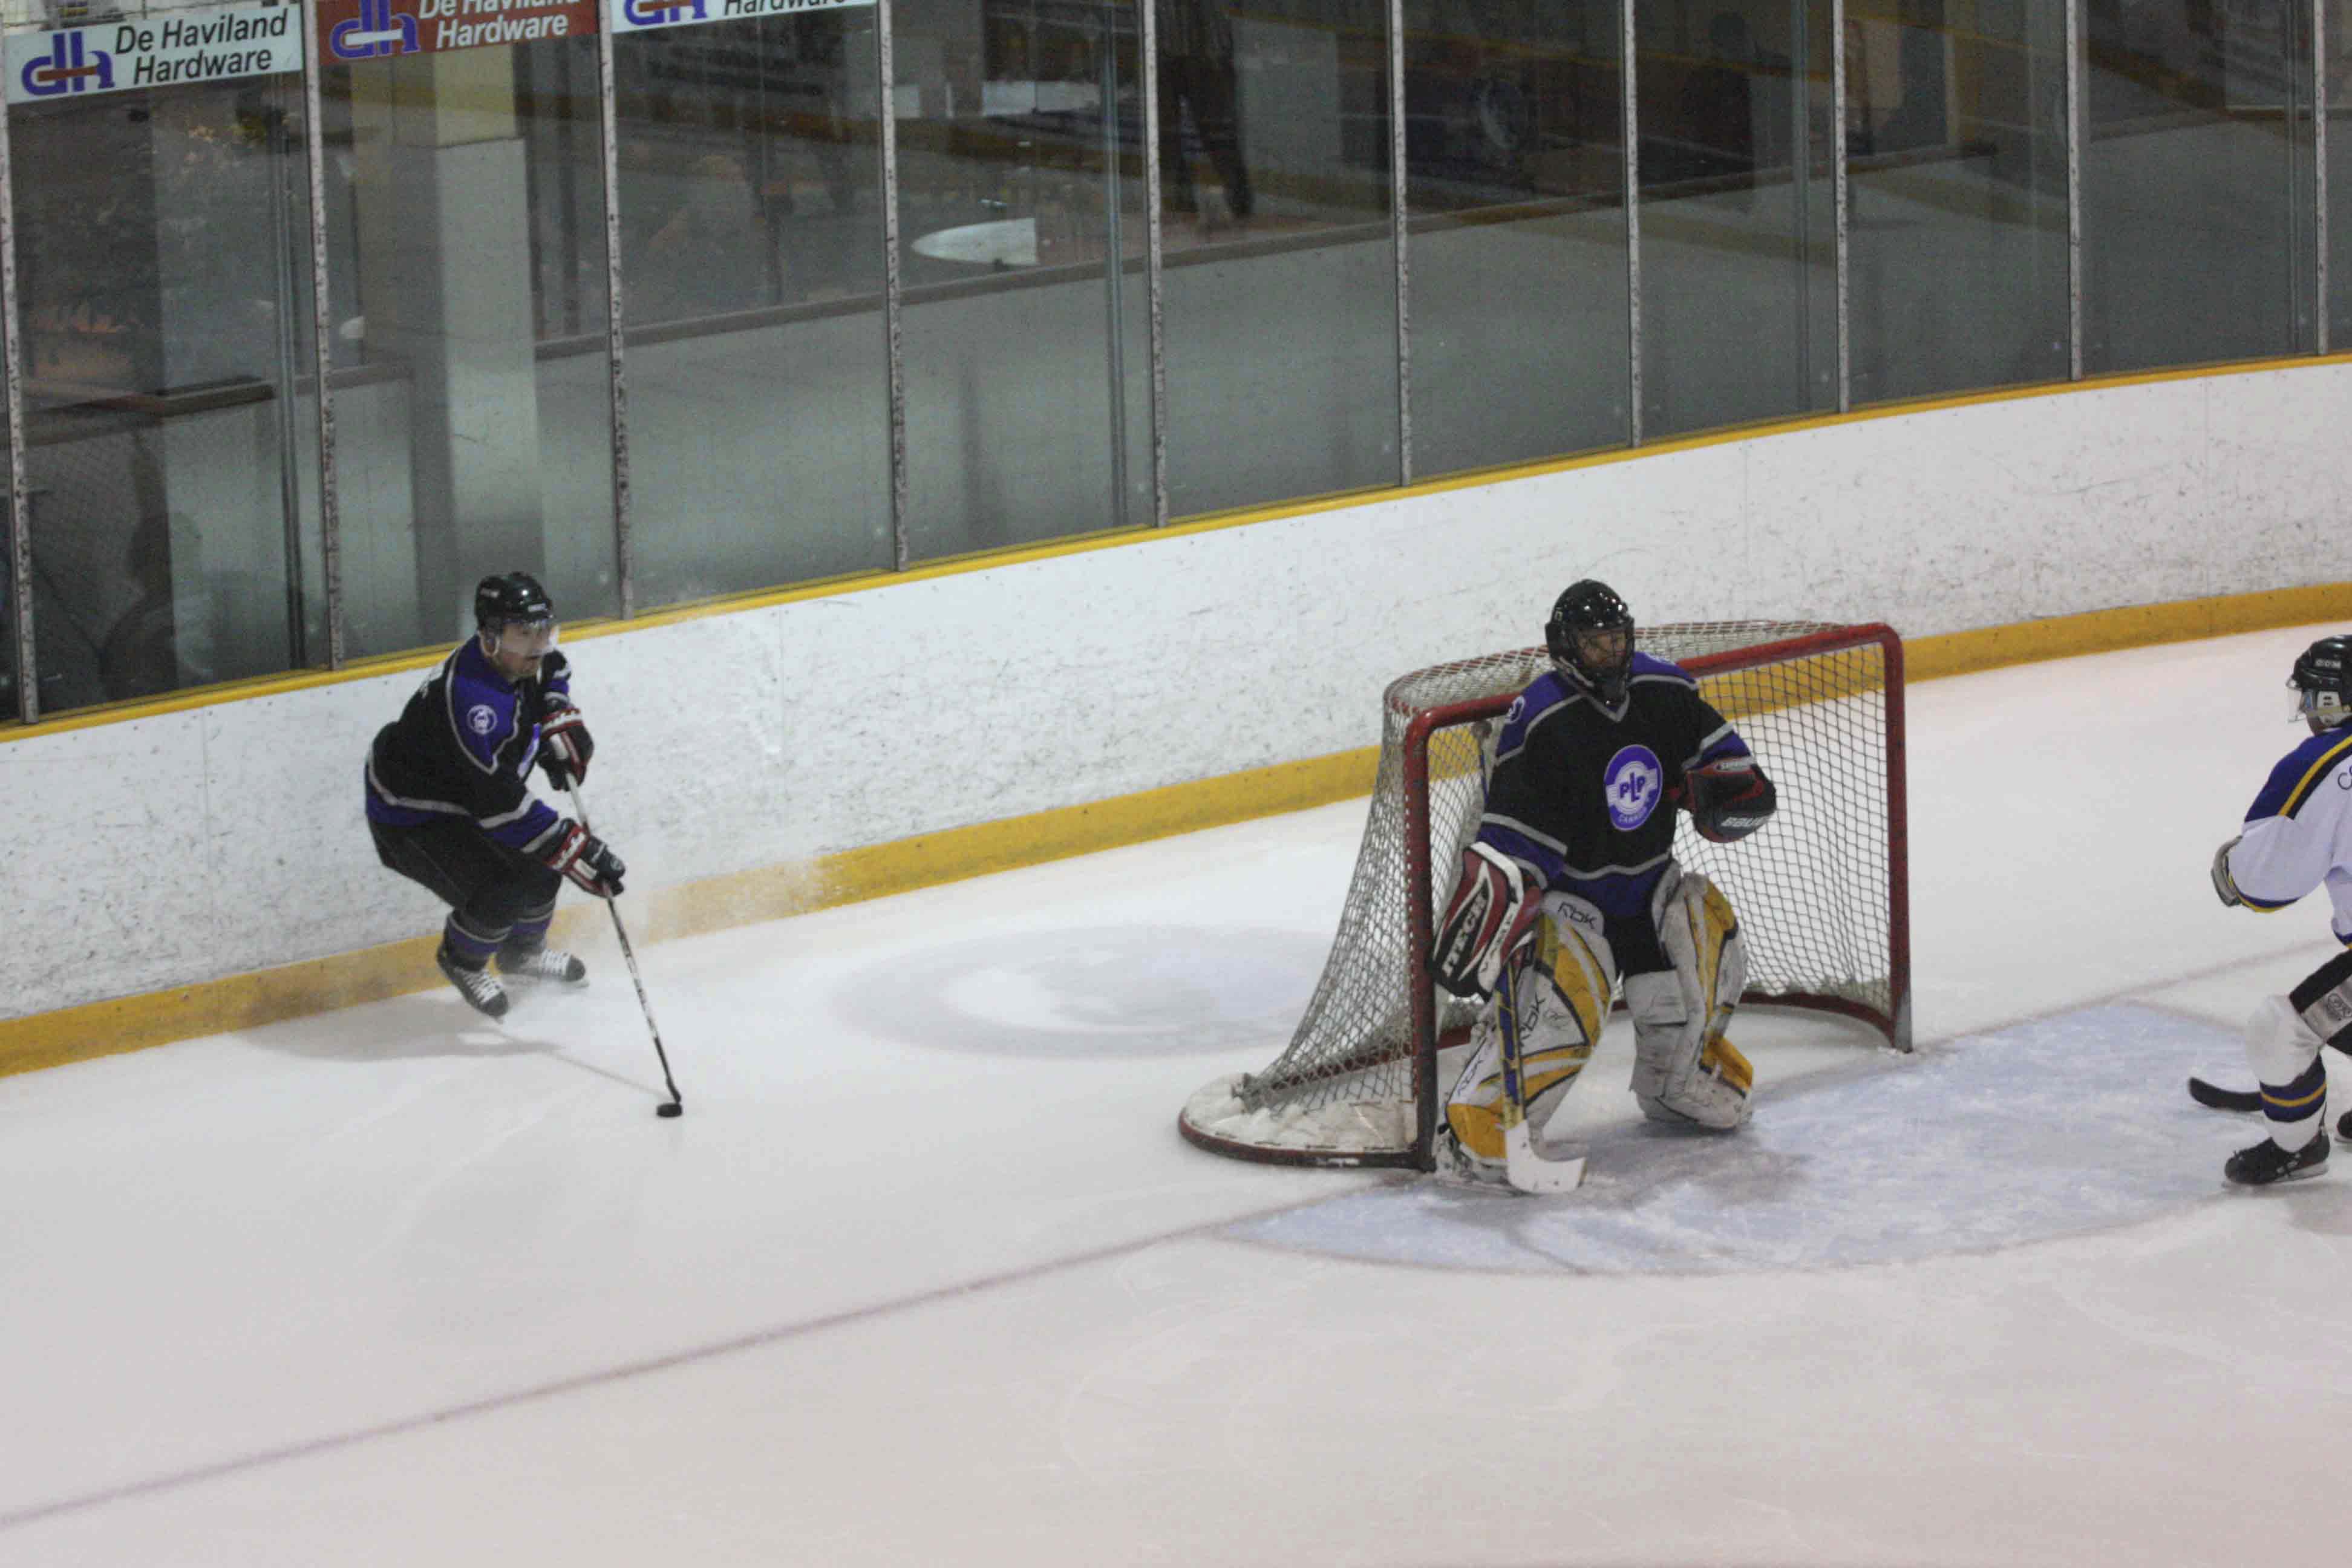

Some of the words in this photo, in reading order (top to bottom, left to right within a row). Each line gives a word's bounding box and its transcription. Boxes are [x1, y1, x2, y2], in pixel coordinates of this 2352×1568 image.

[115, 25, 153, 55] De
[161, 8, 288, 50] Haviland
[436, 13, 568, 49] Hardware
[134, 48, 272, 85] Hardware
